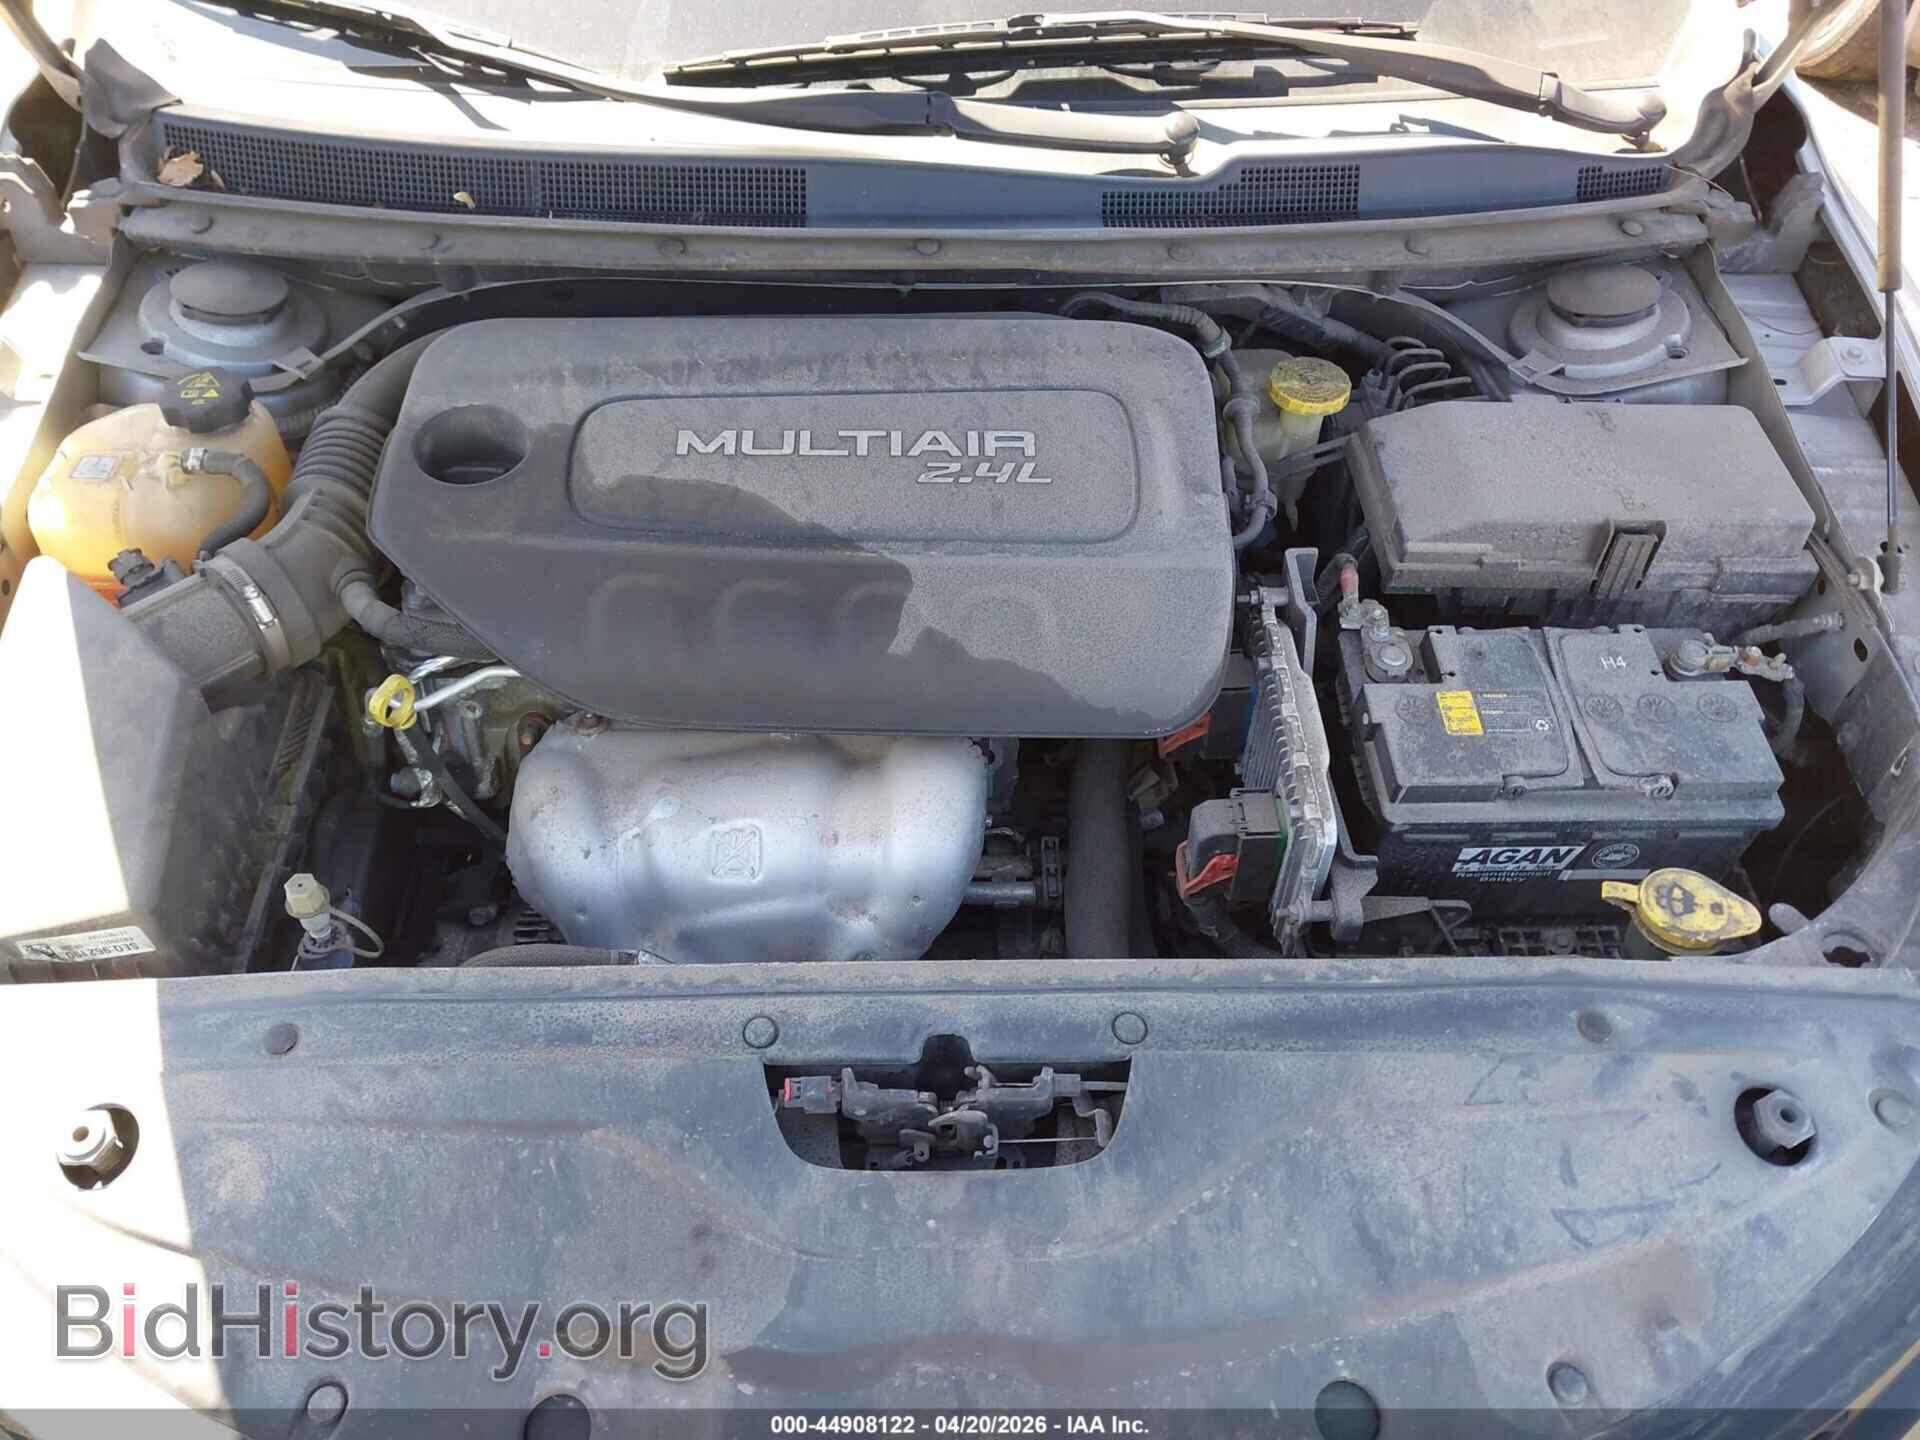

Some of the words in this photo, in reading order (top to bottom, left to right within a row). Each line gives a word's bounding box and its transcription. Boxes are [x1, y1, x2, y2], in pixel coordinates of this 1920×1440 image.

[675, 429, 1037, 457] MULTIAIR
[916, 462, 1052, 484] 2.4L
[1600, 655, 1627, 670] H4
[1457, 847, 1577, 865] AGAN
[1456, 870, 1552, 879] Reconditioned
